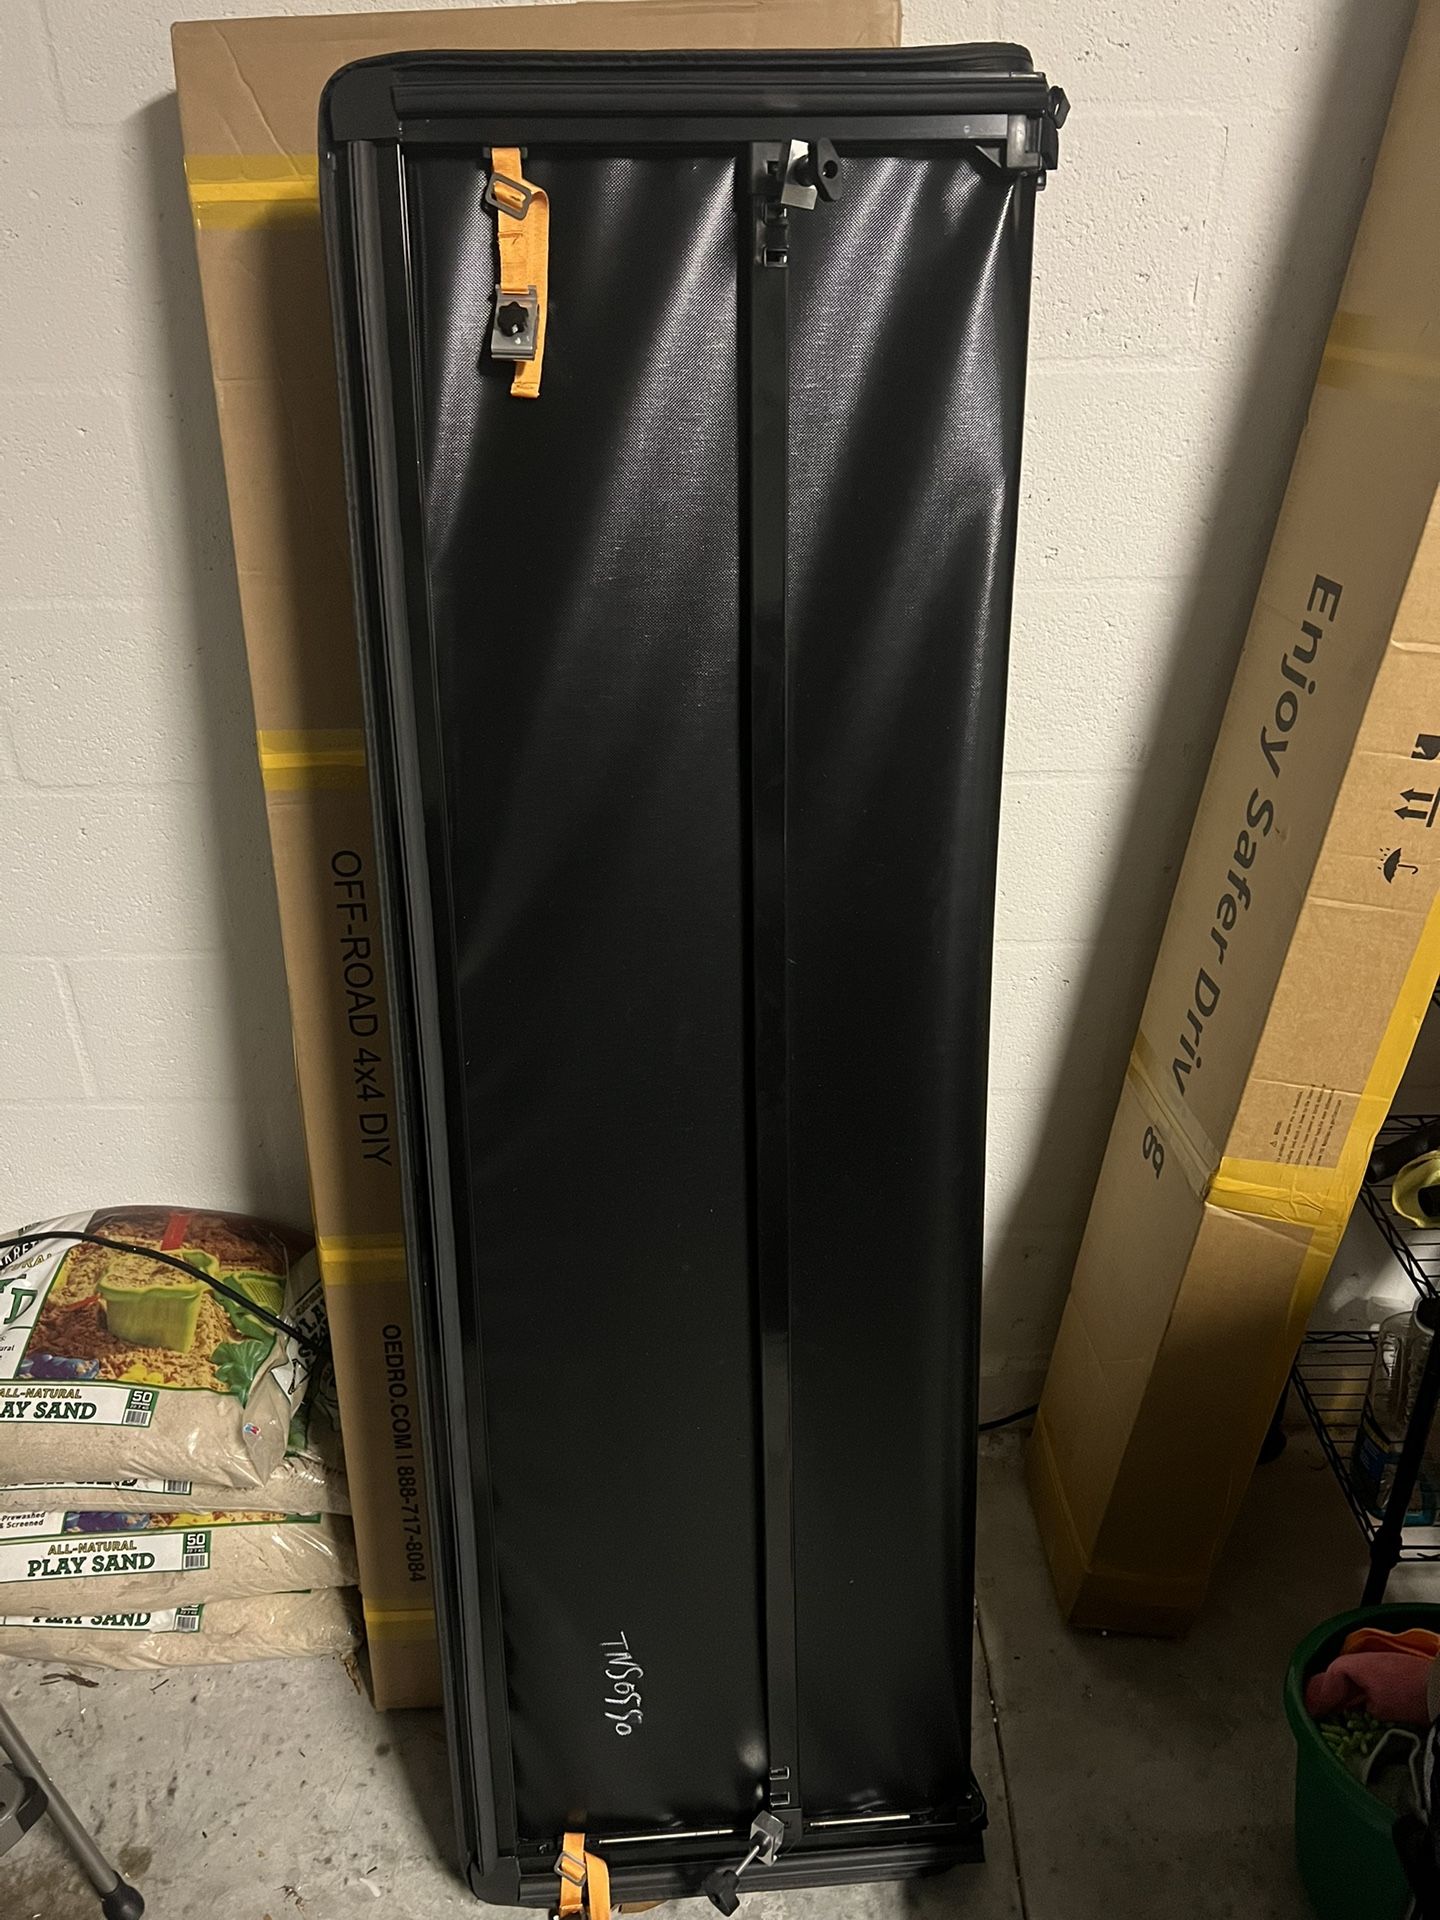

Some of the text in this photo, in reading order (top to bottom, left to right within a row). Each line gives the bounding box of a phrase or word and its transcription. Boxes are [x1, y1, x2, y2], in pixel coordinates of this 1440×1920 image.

[1260, 574, 1343, 779] Enjoy
[1211, 787, 1275, 964] Safer
[331, 849, 392, 1167] OFF-ROAD 4x4 DIY
[132, 1390, 153, 1402] 50
[382, 1324, 414, 1450] OEDRO.COM
[33, 1401, 97, 1419] SAND
[2, 1511, 46, 1521] Prewashed
[6, 1519, 44, 1528] Screened
[397, 1465, 427, 1582] 888-717-8084
[48, 1540, 137, 1555] ALL-NATURAL
[186, 1533, 206, 1546] 50
[28, 1553, 155, 1577] PLAY SAND
